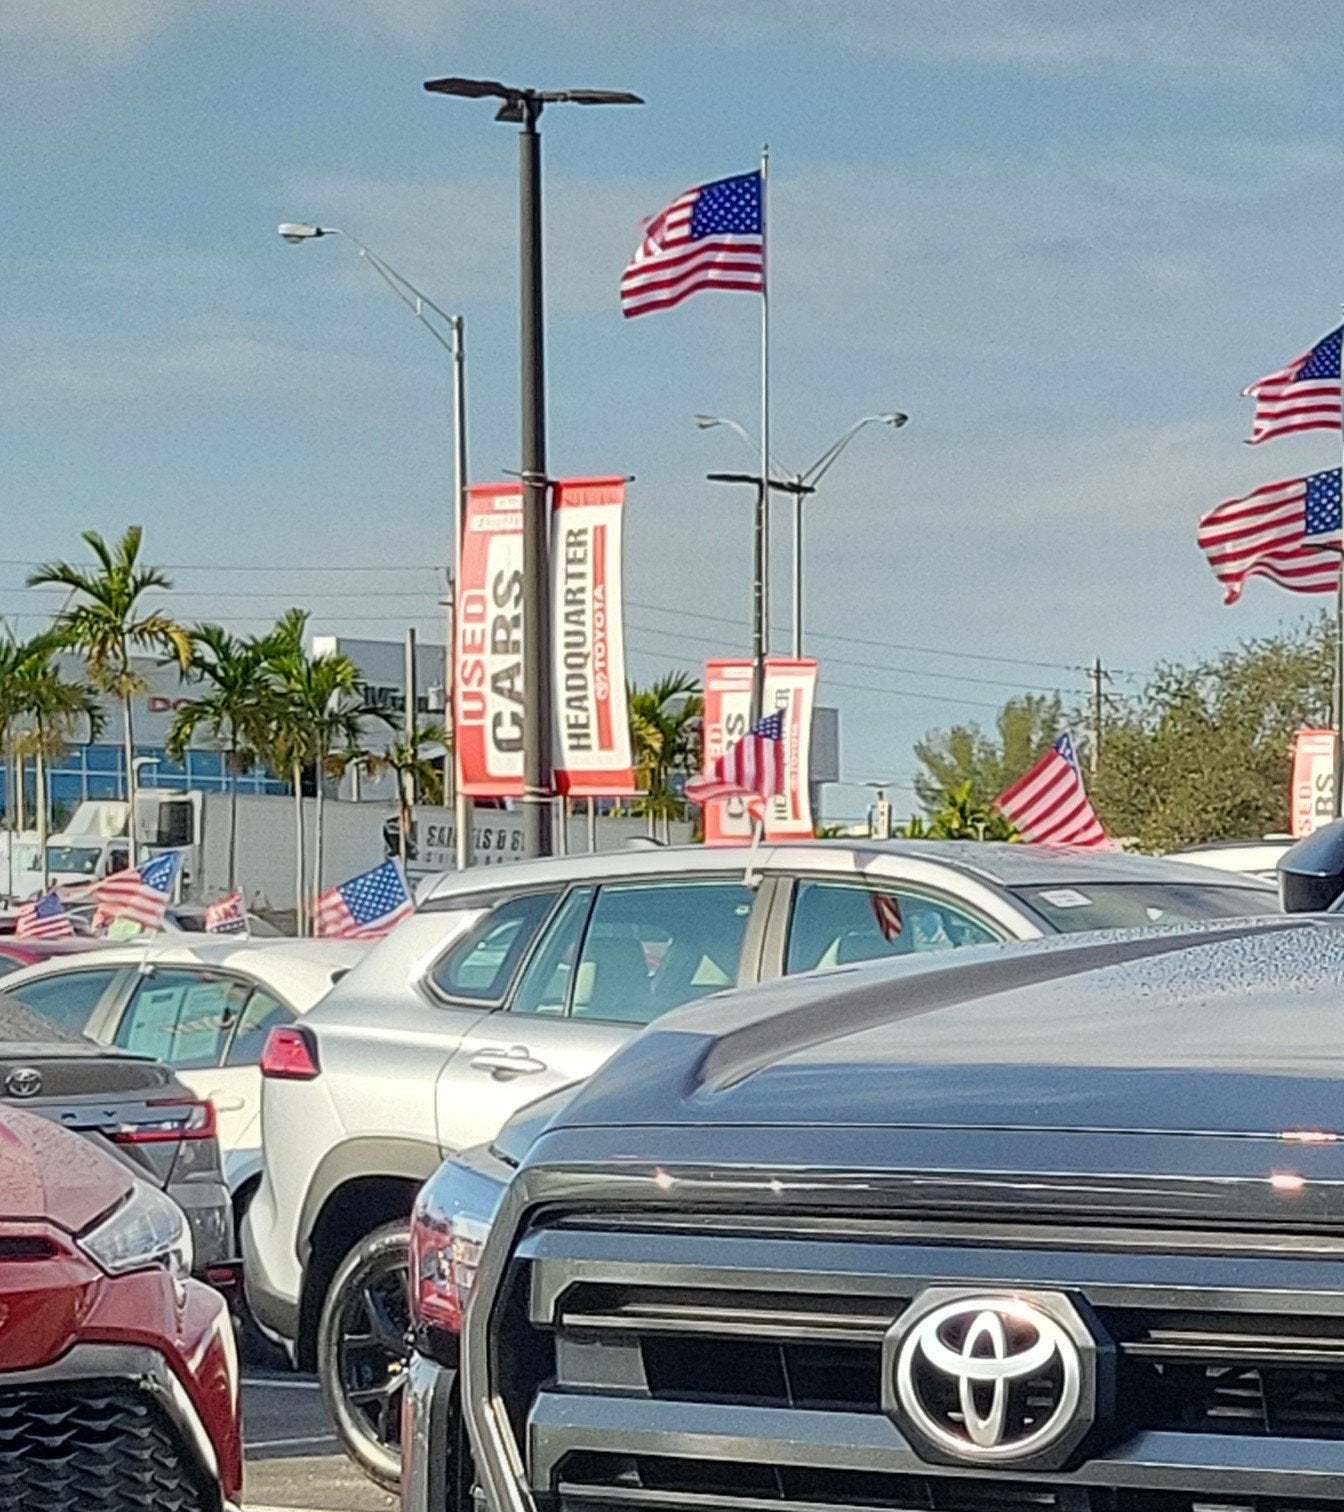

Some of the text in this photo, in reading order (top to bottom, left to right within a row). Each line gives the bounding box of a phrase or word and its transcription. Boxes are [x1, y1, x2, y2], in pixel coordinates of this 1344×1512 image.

[461, 594, 486, 722] USED
[490, 568, 524, 754] CARS
[563, 526, 593, 752] HEADQUARTER
[592, 584, 608, 670] TOYOTA
